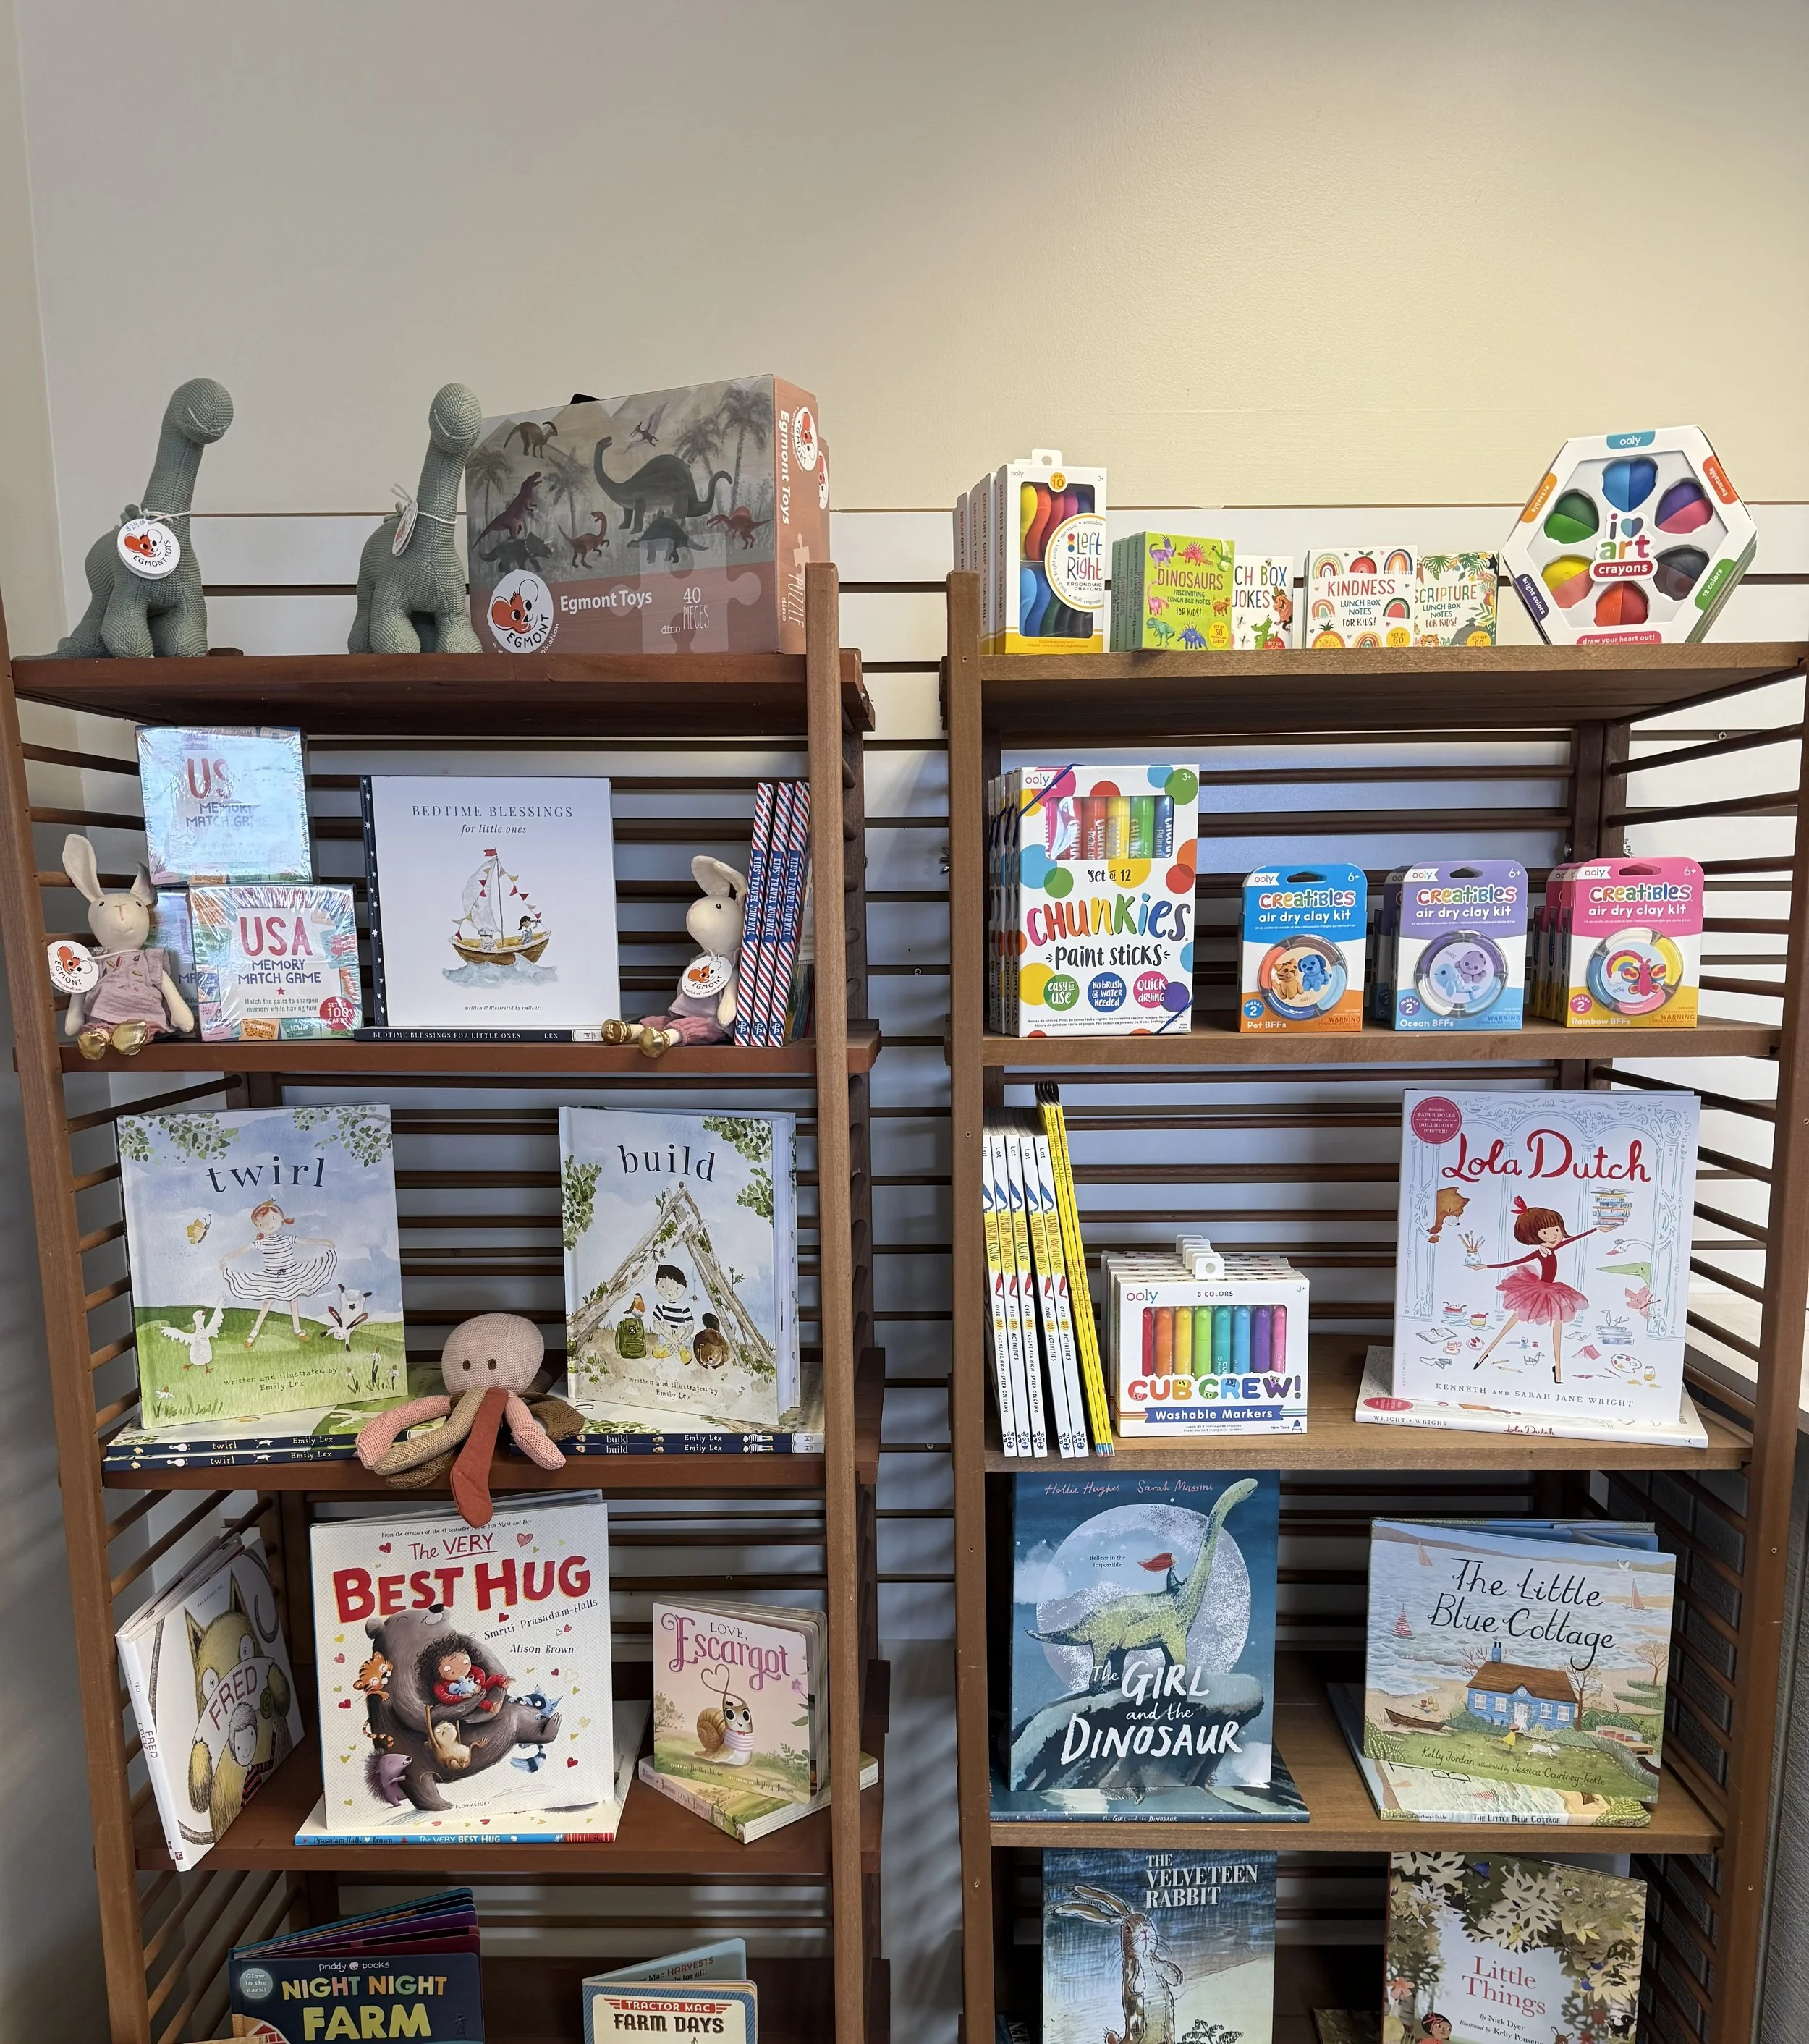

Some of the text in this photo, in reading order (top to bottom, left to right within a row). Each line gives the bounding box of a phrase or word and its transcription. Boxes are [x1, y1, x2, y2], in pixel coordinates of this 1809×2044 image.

[1619, 436, 1641, 447] ooly
[779, 410, 791, 525] Egmont Toys
[1052, 479, 1064, 488] 10
[1709, 466, 1728, 498] twistable
[1531, 485, 1550, 514] erasable
[133, 540, 172, 567] EGMONT TOYS
[1077, 532, 1102, 555] Left
[1600, 535, 1650, 560] art
[1067, 556, 1103, 580] Right
[1158, 569, 1223, 590] DINOSAURS
[1261, 566, 1287, 587] BOX
[1598, 564, 1648, 576] crayons
[1328, 579, 1395, 597] KINDNESS
[1702, 568, 1723, 597] 12 colors
[560, 590, 652, 615] Egmont Toys
[684, 588, 701, 603] 40
[1232, 590, 1270, 608] JOKES
[1522, 577, 1546, 614] bright colors
[683, 605, 710, 631] PIECES
[507, 612, 550, 649] EGMONT
[1600, 636, 1617, 645] your
[1025, 774, 1049, 787] ooly
[412, 805, 573, 817] BEDTIME BLESSINGS
[460, 824, 475, 835] for
[479, 824, 502, 834] little
[750, 877, 760, 902] TRAVEL
[1255, 874, 1274, 885] ooly
[747, 905, 758, 935] JOURNAL
[1589, 904, 1686, 919] air dry clay kit
[240, 916, 313, 957] USA
[252, 959, 305, 971] MEMORY
[239, 972, 321, 984] MATCH GAME
[618, 1144, 715, 1182] build
[1441, 1129, 1651, 1183] Lola Dutch
[206, 1155, 325, 1192] twirl
[1127, 1289, 1158, 1304] ooly
[1128, 1375, 1301, 1401] CUB CREW!
[1436, 1383, 1486, 1394] KENNETH
[1515, 1391, 1550, 1400] SARAH
[1556, 1394, 1583, 1403] JANE
[1588, 1397, 1633, 1407] WRIGHT
[1156, 1409, 1272, 1420] Washable Markers
[212, 1441, 237, 1451] twirl
[292, 1436, 316, 1445] Emily
[606, 1433, 628, 1443] build
[685, 1433, 706, 1443] Emily
[1044, 1480, 1213, 1498] Hollie Hughes Sarah Massini
[407, 1533, 493, 1560] The VERY
[333, 1556, 592, 1624] BEST HUG
[1451, 1557, 1603, 1607] The Little
[484, 1598, 598, 1640] Smriti Prasadam-Halls
[711, 1622, 747, 1640] LOVE,
[1427, 1593, 1616, 1671] Blue Cottage
[510, 1643, 575, 1654] Alison Brown
[661, 1613, 790, 1690] Escargot
[1090, 1661, 1210, 1706] The GIRL
[208, 1665, 258, 1732] FRED
[1126, 1702, 1194, 1720] and the
[1061, 1713, 1242, 1766] DINOSAUR
[1422, 1746, 1444, 1765] Kelly
[1446, 1750, 1474, 1765] Jordan
[1512, 1763, 1541, 1777] Jessica
[1146, 1854, 1172, 1867] THE
[1146, 1865, 1258, 1888] VELVETEEN
[1145, 1887, 1221, 1909] RABBIT
[319, 1962, 347, 1972] priddy
[1473, 1955, 1536, 1989] Little
[281, 1975, 447, 2000] NIGHT NIGHT
[1462, 1975, 1546, 2017] Things
[627, 2001, 711, 2012] TRACTOR MAC
[303, 2003, 431, 2041] FARM
[614, 2013, 724, 2034] FARM DAYS
